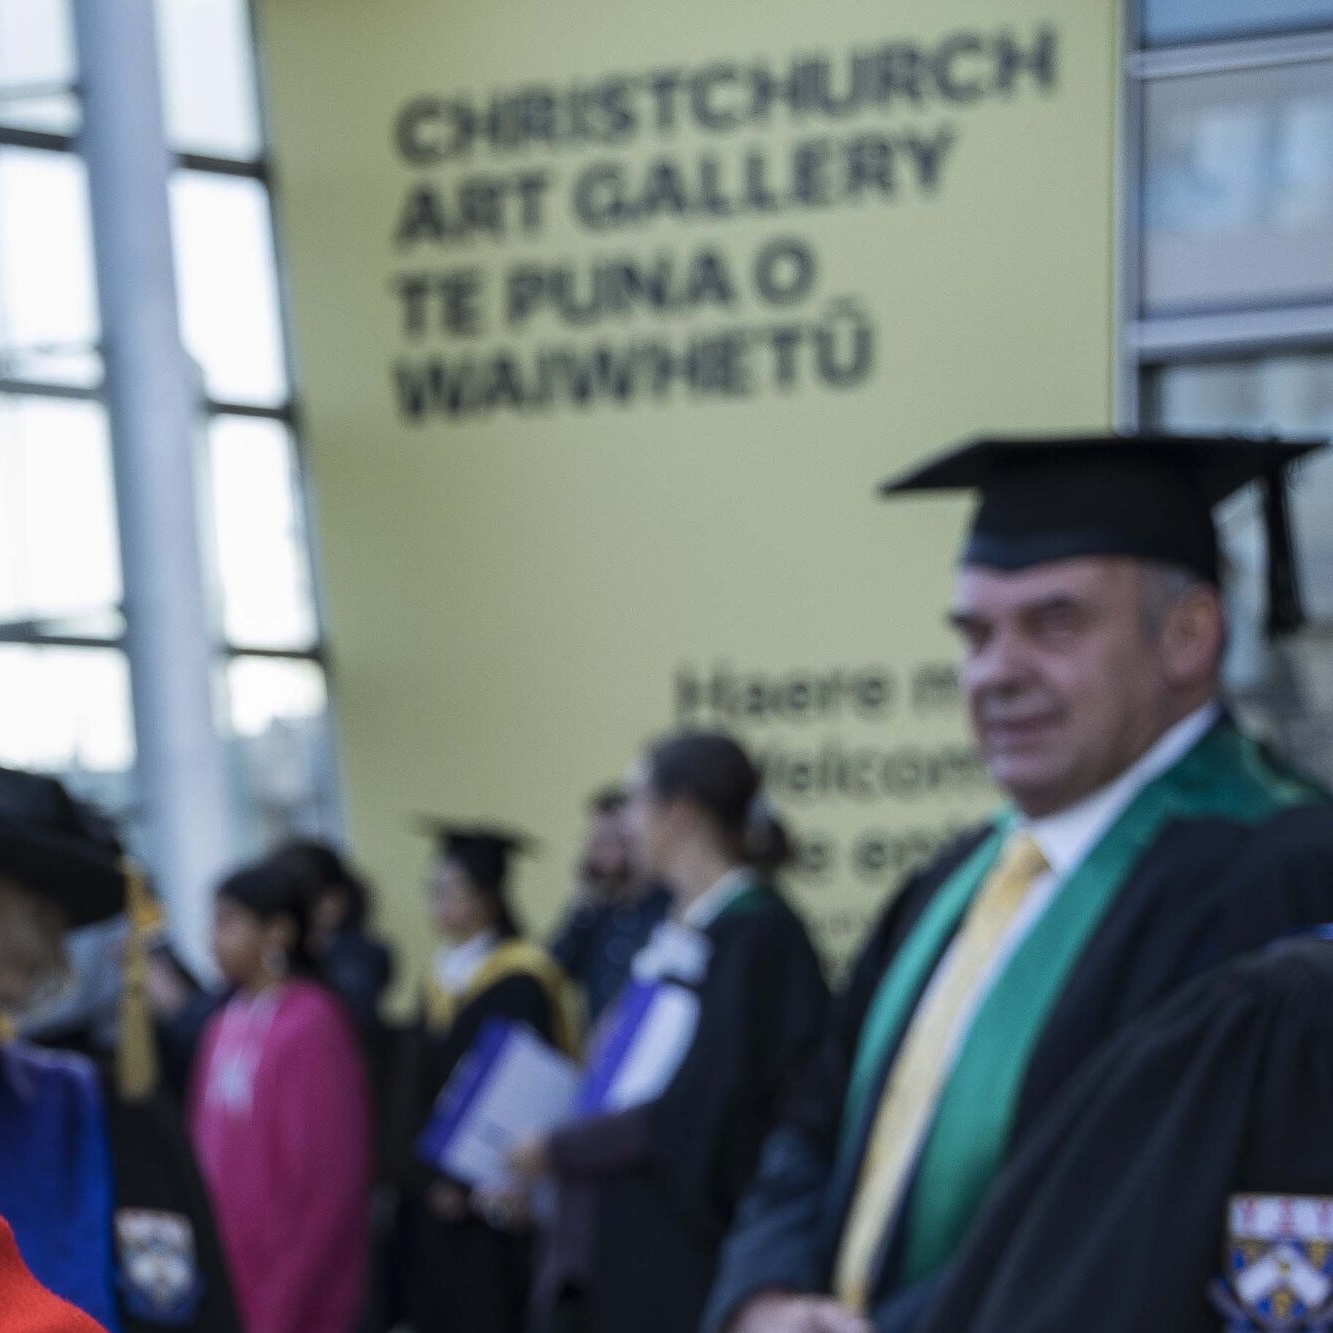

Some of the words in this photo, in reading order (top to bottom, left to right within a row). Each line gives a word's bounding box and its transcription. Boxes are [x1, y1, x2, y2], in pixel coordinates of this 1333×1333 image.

[396, 28, 1058, 166] CHRISTCHURCH
[396, 172, 545, 247] ART
[572, 126, 956, 230] GALLERY
[396, 268, 482, 337] TE
[504, 248, 733, 329] PUNA
[753, 236, 816, 303] O
[396, 299, 874, 424] WAIWHETŪ
[674, 662, 892, 722] Haere
